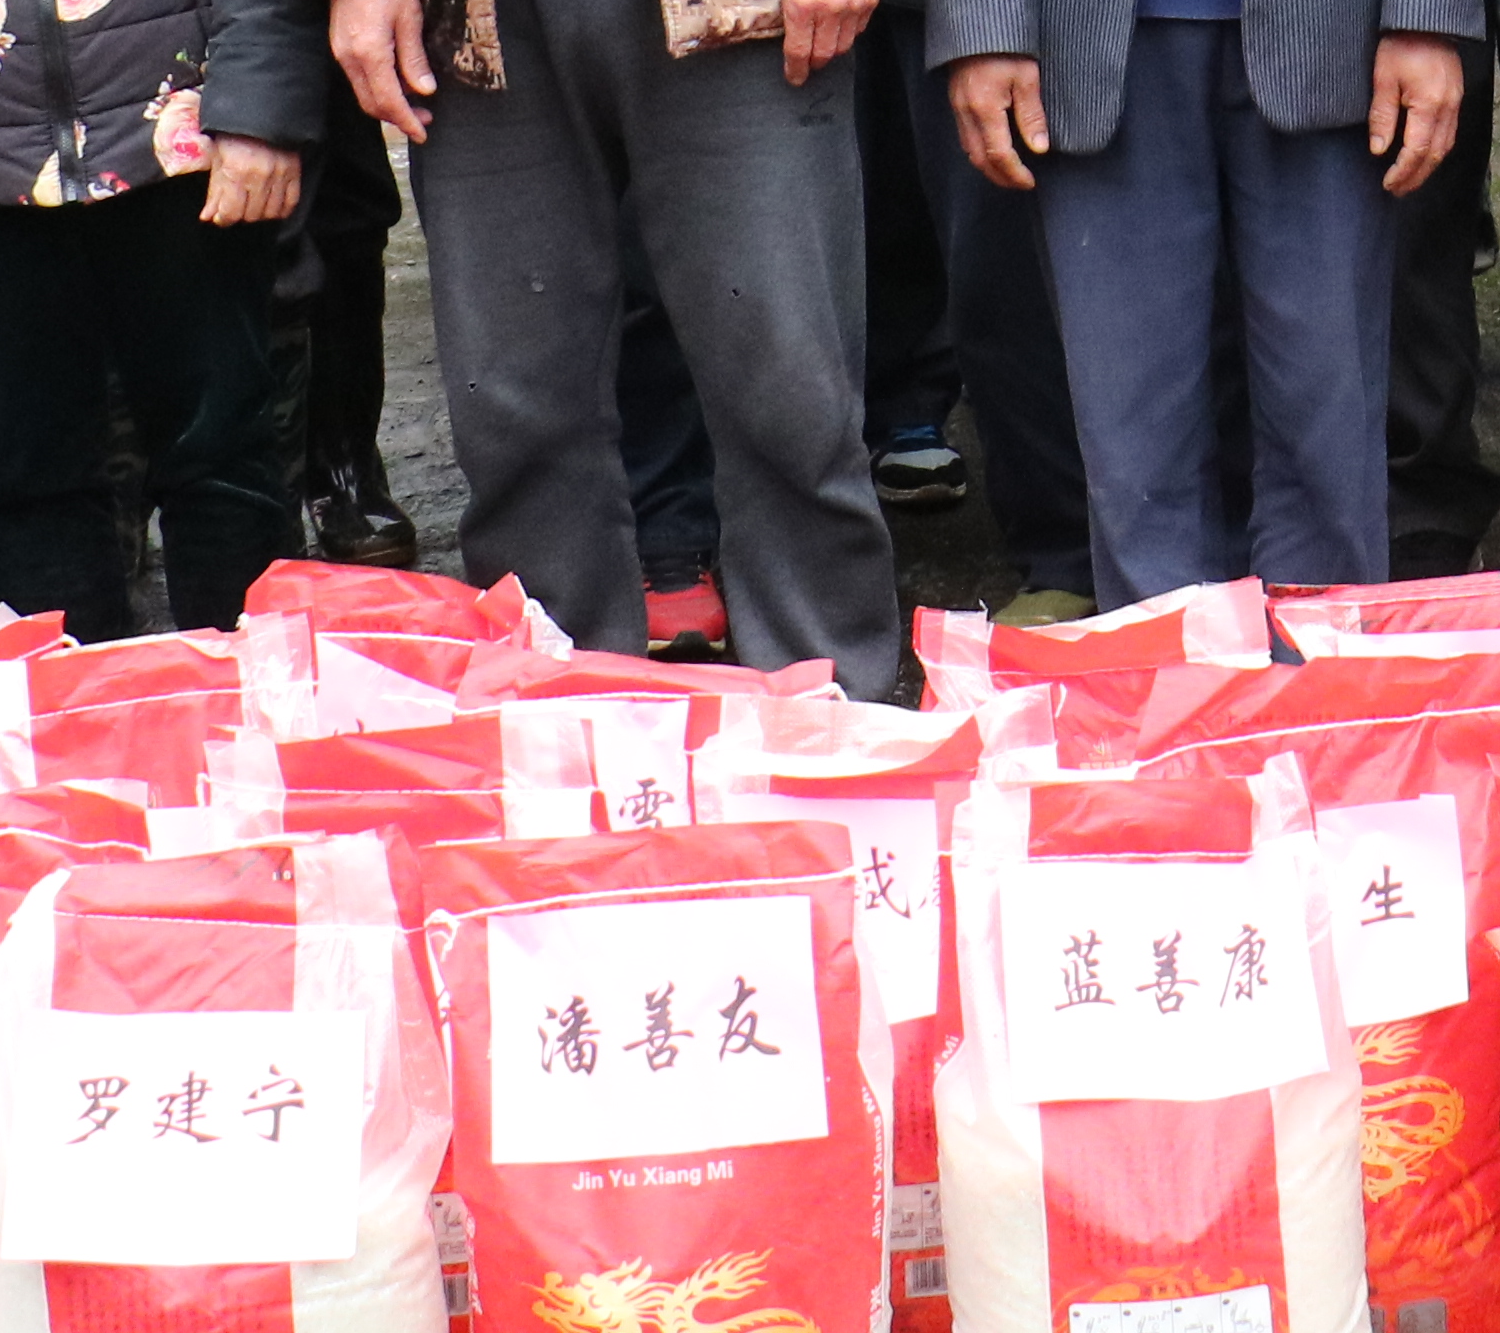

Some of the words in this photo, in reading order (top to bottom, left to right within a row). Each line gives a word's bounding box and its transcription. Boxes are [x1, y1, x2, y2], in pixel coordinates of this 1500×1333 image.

[1360, 864, 1416, 927] 生
[1054, 923, 1270, 1015] 蓝善康
[538, 975, 781, 1076] 潘善友
[66, 1064, 305, 1144] 罗建宁
[571, 1168, 603, 1192] Jin
[609, 1167, 637, 1189] Yu
[642, 1163, 703, 1187] Xiang
[707, 1160, 734, 1182] Mi
